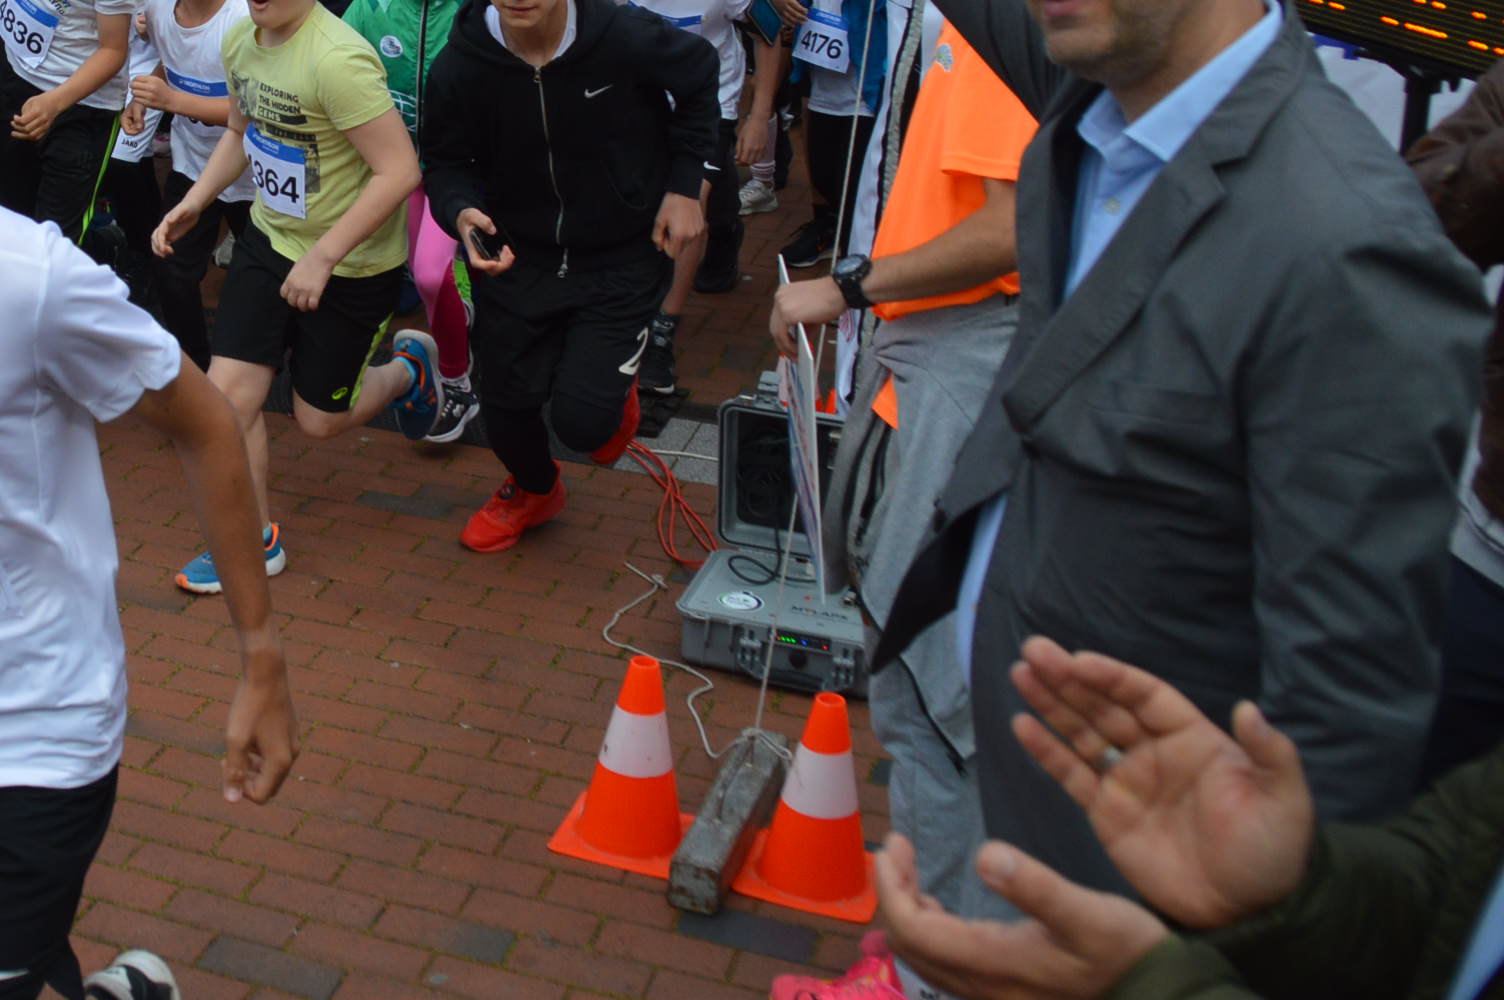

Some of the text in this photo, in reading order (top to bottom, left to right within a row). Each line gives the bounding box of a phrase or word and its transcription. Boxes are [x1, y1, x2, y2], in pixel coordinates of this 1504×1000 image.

[0, 0, 44, 55] 4836
[801, 29, 843, 60] 4176
[260, 82, 299, 103] EXPLORING
[248, 154, 300, 203] 364
